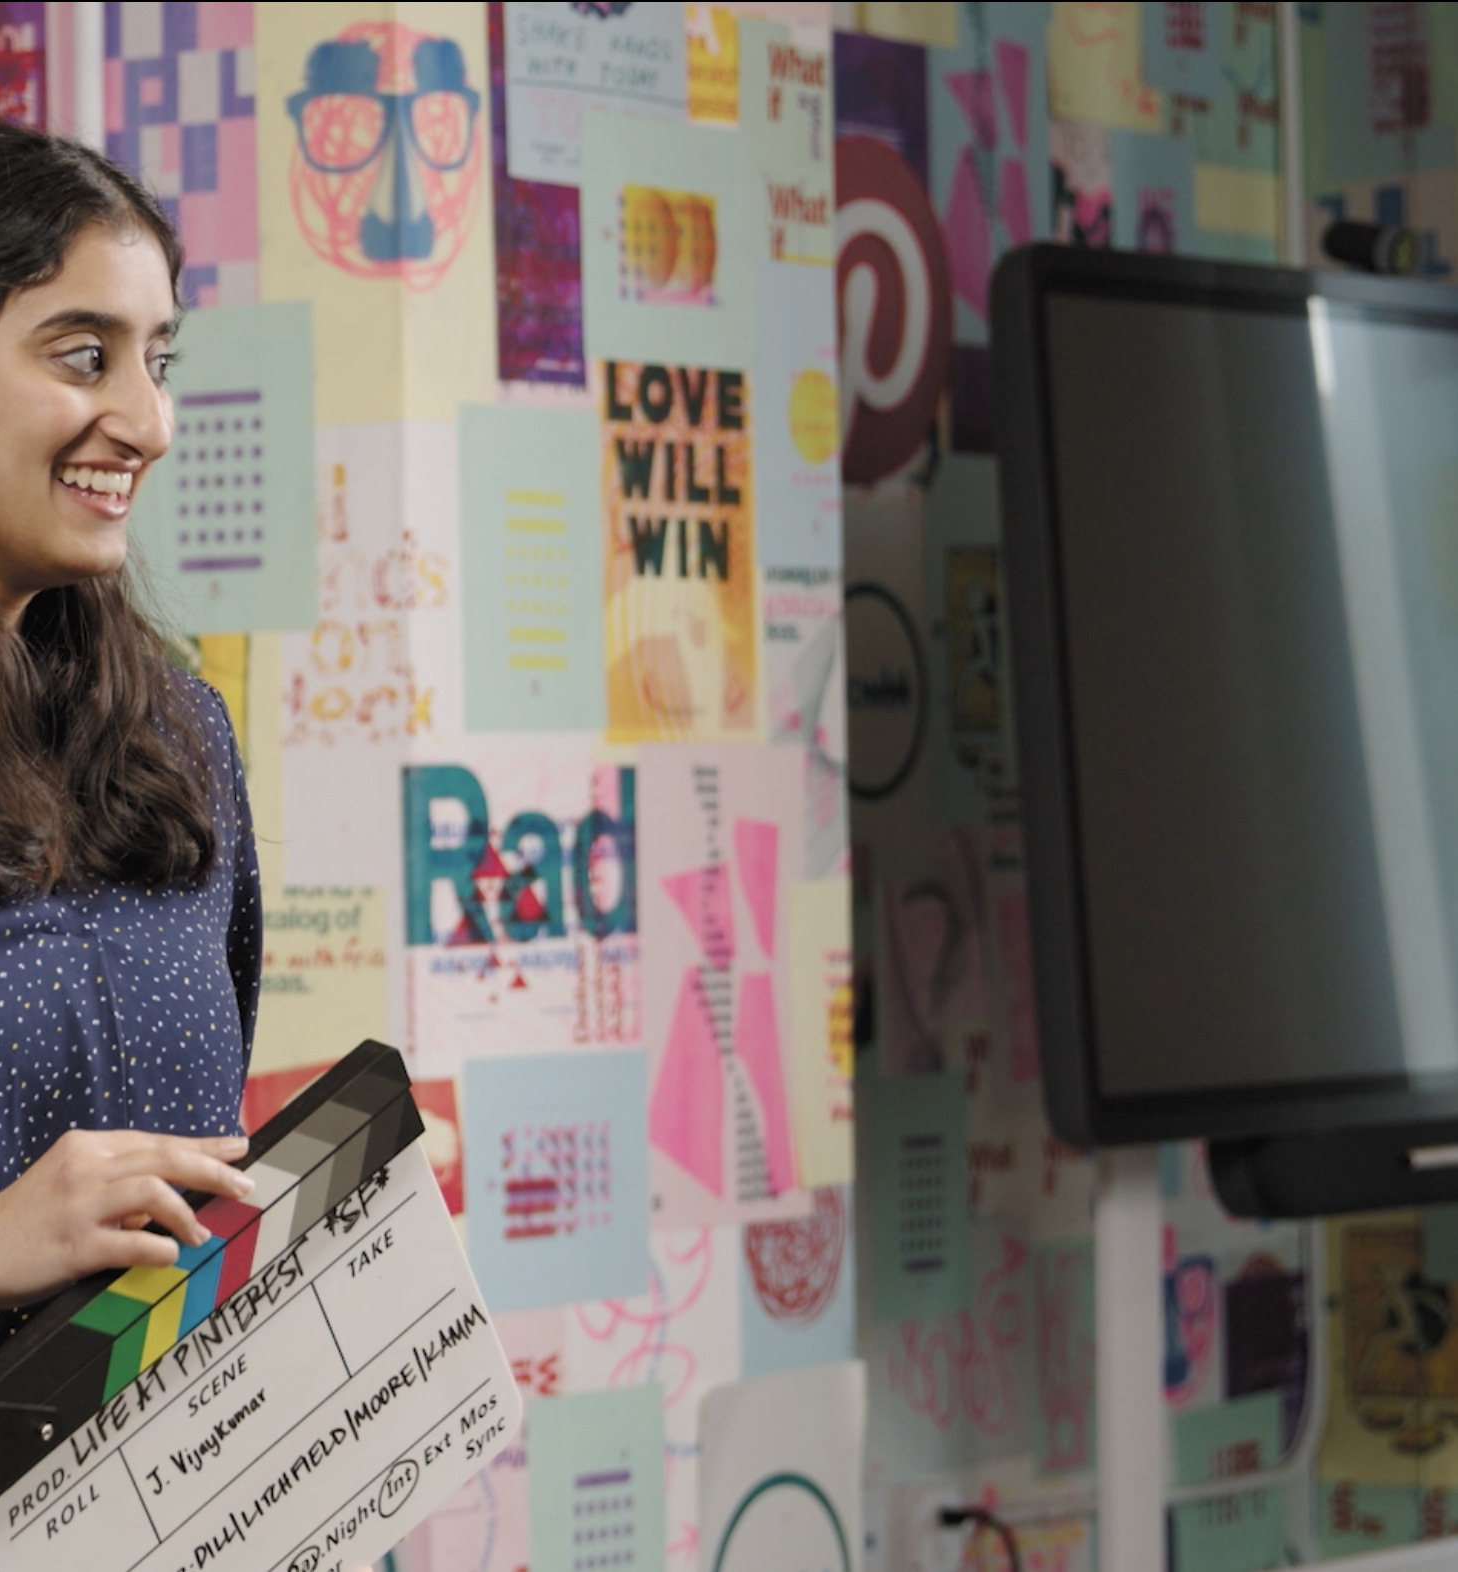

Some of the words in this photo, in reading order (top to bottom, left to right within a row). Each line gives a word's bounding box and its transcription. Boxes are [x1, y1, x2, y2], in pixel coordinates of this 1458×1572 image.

[767, 40, 826, 88] What
[768, 182, 830, 227] What
[604, 360, 745, 429] LOVE
[615, 438, 741, 505] WILL
[628, 516, 729, 580] WIN
[402, 765, 638, 947] Rad
[335, 903, 361, 929] of
[345, 1227, 395, 1279] TAKE
[68, 1393, 132, 1477] LIFE
[134, 1357, 167, 1413] AT
[172, 1234, 310, 1377] PINTEREST
[187, 1353, 248, 1418] SCENE
[386, 1466, 413, 1499] Int
[423, 1432, 452, 1468] Ext
[459, 1394, 498, 1435] Mos
[465, 1416, 507, 1460] Sync
[8, 1467, 73, 1528] PROD.
[145, 1464, 172, 1496] J.
[46, 1484, 101, 1540] ROLL
